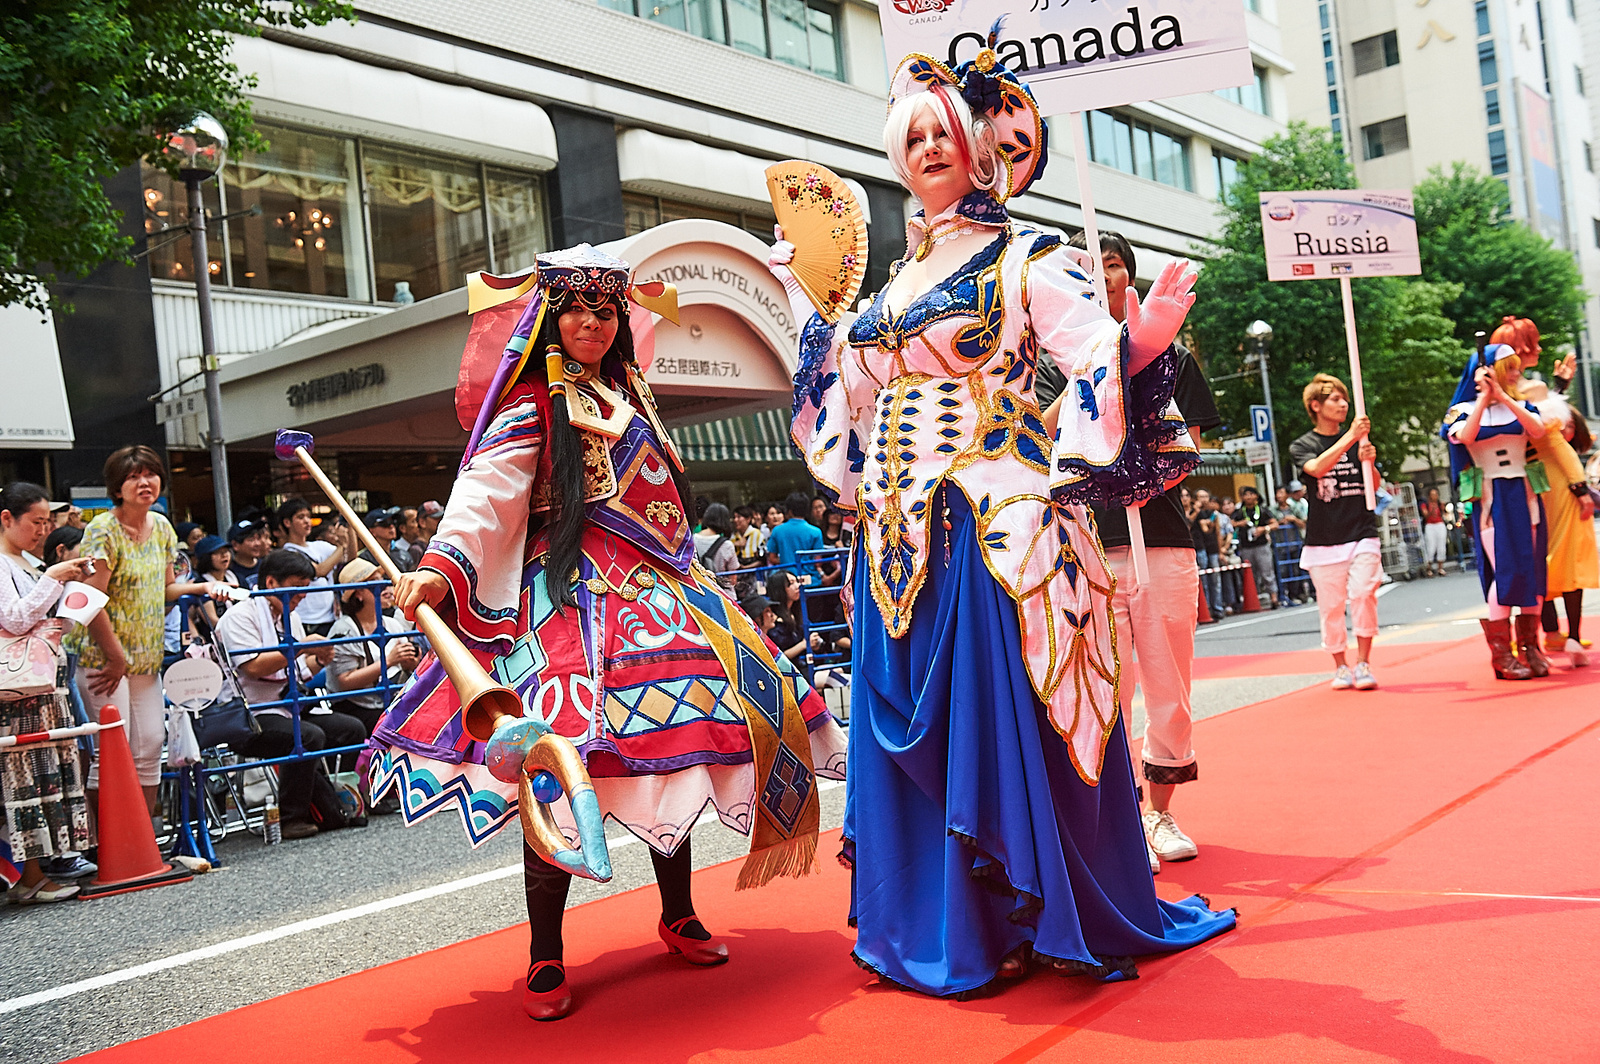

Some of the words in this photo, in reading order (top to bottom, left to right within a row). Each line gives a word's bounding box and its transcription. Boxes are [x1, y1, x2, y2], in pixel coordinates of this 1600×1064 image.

[909, 15, 943, 26] CANADA
[948, 7, 1184, 74] Canada
[1327, 214, 1363, 227] ロシア
[1294, 229, 1389, 256] Russia
[711, 265, 750, 296] HOTEL
[753, 286, 799, 346] NAGOYA
[655, 357, 742, 378] 名古屋国際ホテル
[1255, 409, 1269, 440] P
